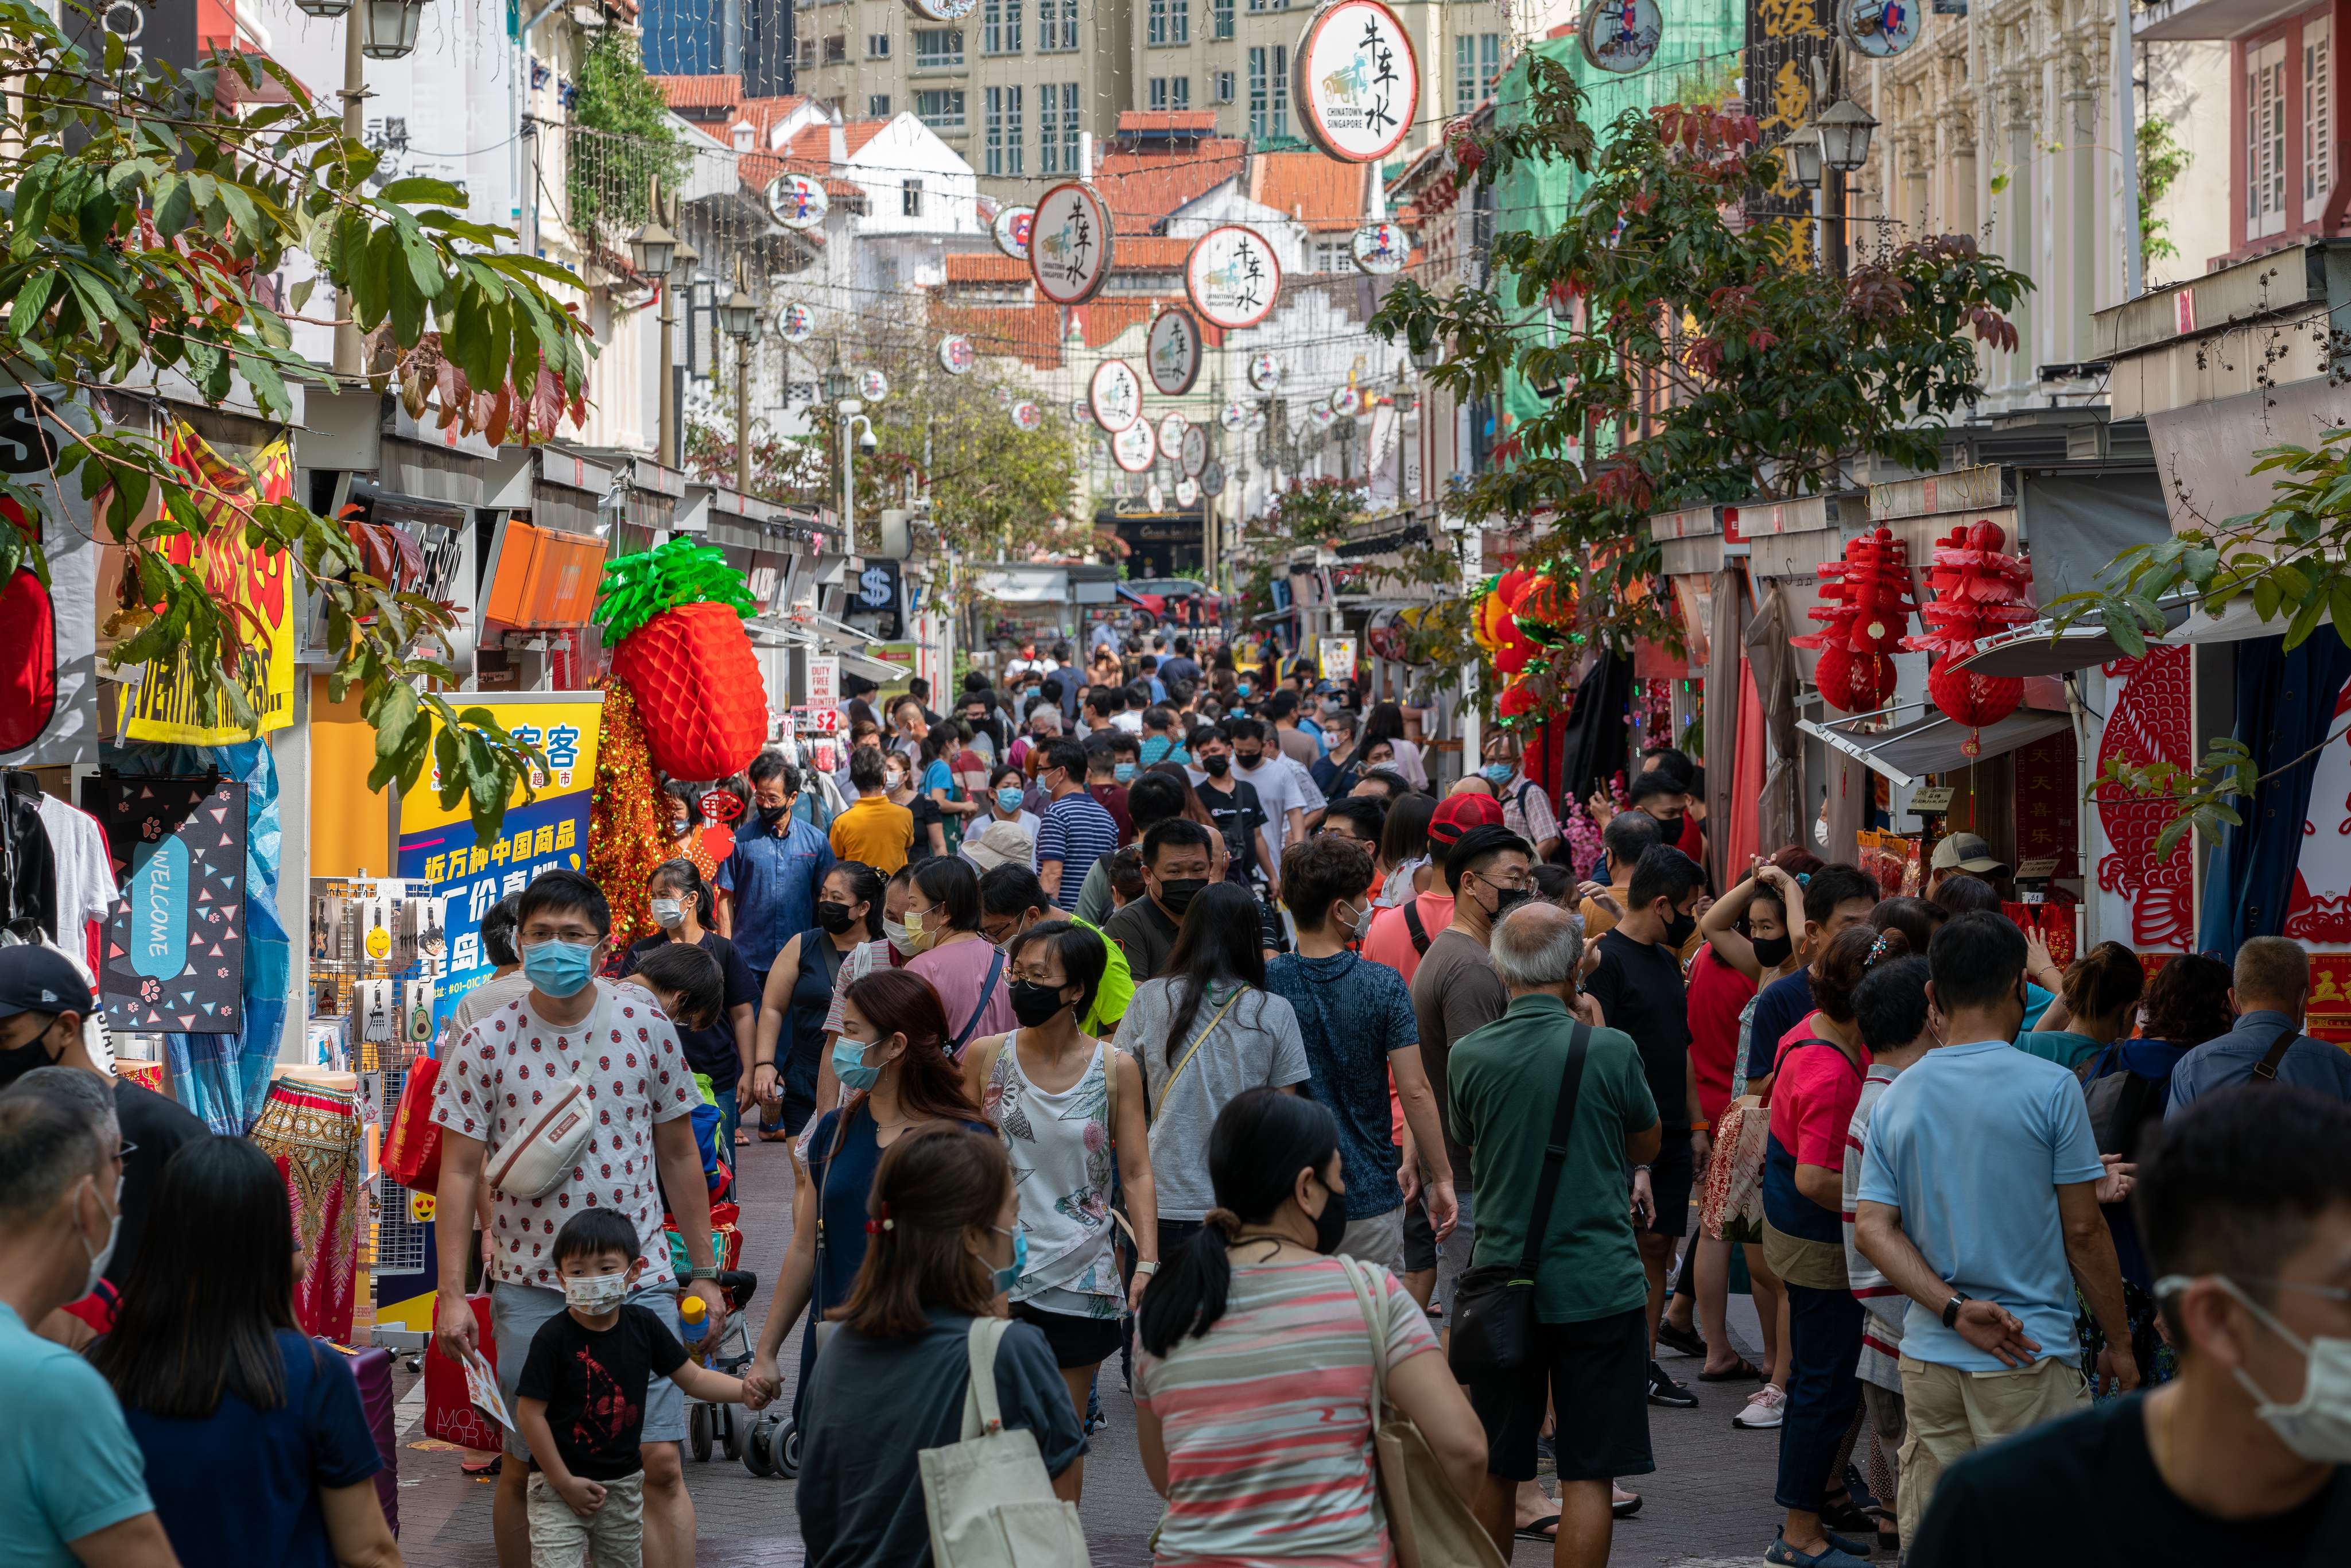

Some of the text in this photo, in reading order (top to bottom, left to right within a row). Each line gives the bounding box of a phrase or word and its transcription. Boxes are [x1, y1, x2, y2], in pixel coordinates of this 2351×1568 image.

[1359, 14, 1399, 138] 牛车水
[1327, 107, 1363, 117] CHINATOWN
[1327, 119, 1363, 129] SINGAPORE
[1066, 196, 1092, 288] 牛车水
[1041, 262, 1065, 272] CHINATOWN
[1041, 270, 1064, 280] SINGAPORE
[1234, 236, 1264, 312] 牛车水
[812, 666, 830, 675] DUTY
[813, 677, 829, 685] FREE
[806, 697, 836, 706] COUNTER
[817, 712, 836, 730] $2
[2029, 748, 2053, 844] 天天喜乐
[149, 851, 170, 957] WELCOME
